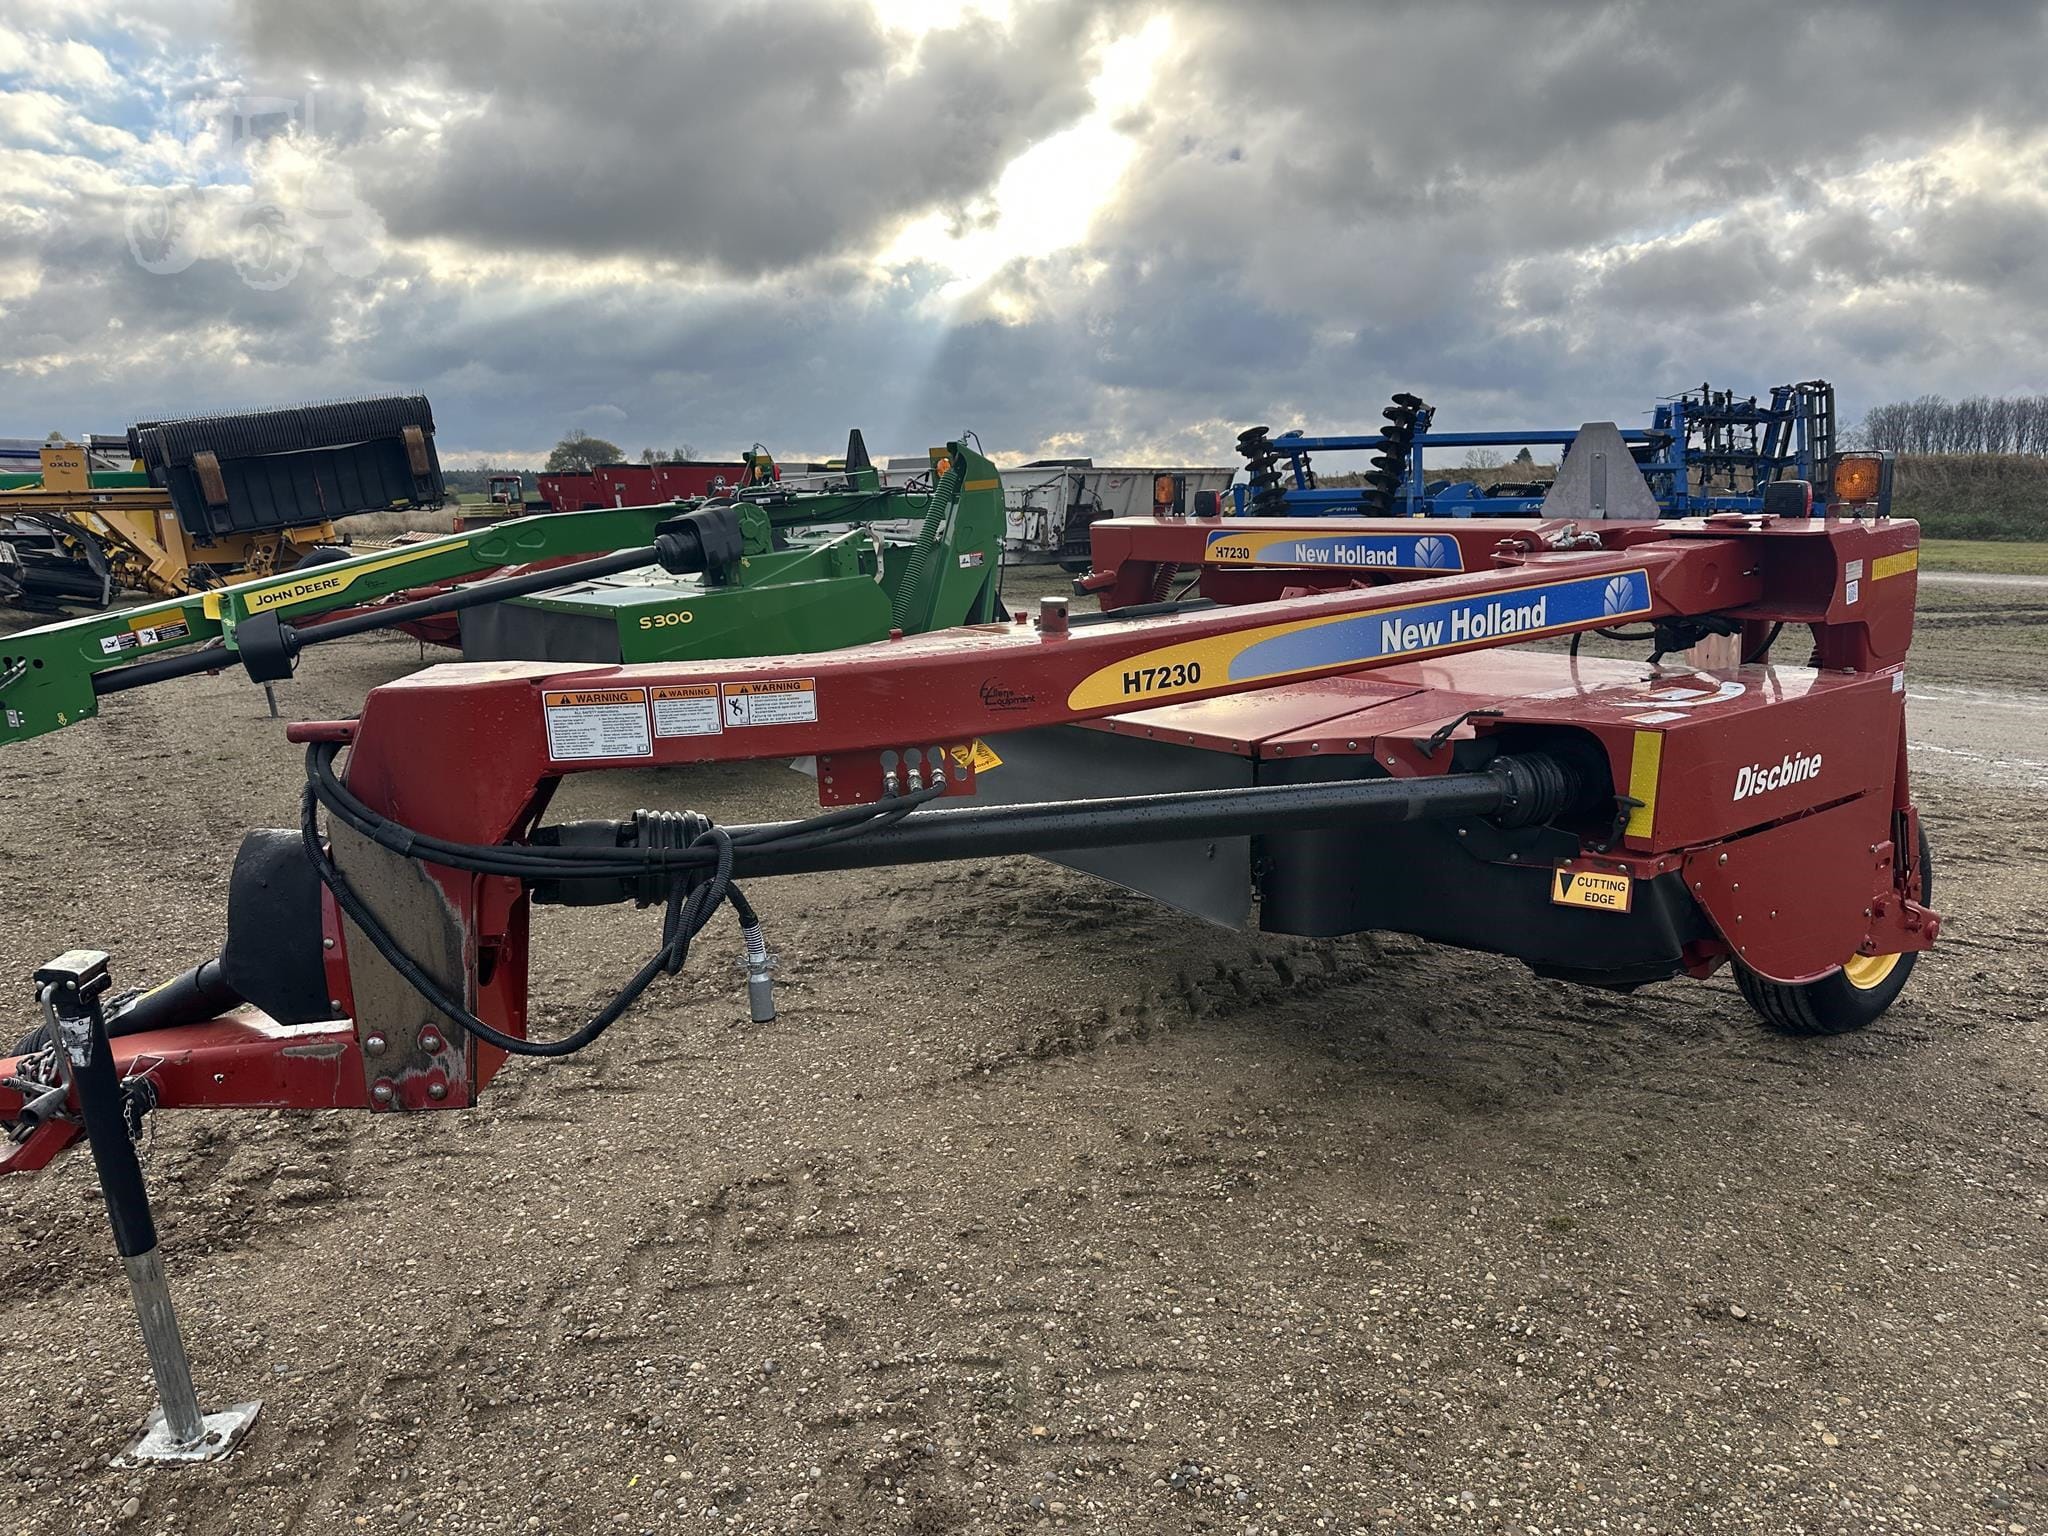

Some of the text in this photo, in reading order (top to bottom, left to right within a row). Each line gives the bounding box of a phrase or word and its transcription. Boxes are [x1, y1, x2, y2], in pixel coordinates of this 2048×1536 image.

[50, 460, 79, 468] oxbo
[1215, 546, 1250, 560] H7230
[1295, 543, 1397, 566] New Holland
[639, 610, 693, 630] S300
[1380, 595, 1546, 655] New Holland
[1122, 661, 1201, 695] H7230
[668, 687, 711, 697] WARNING
[751, 681, 801, 692] WARNING
[575, 692, 628, 703] WARNING
[1733, 751, 1823, 801] Discbine
[1577, 876, 1626, 892] CUTTING
[1584, 891, 1616, 905] EDGE
